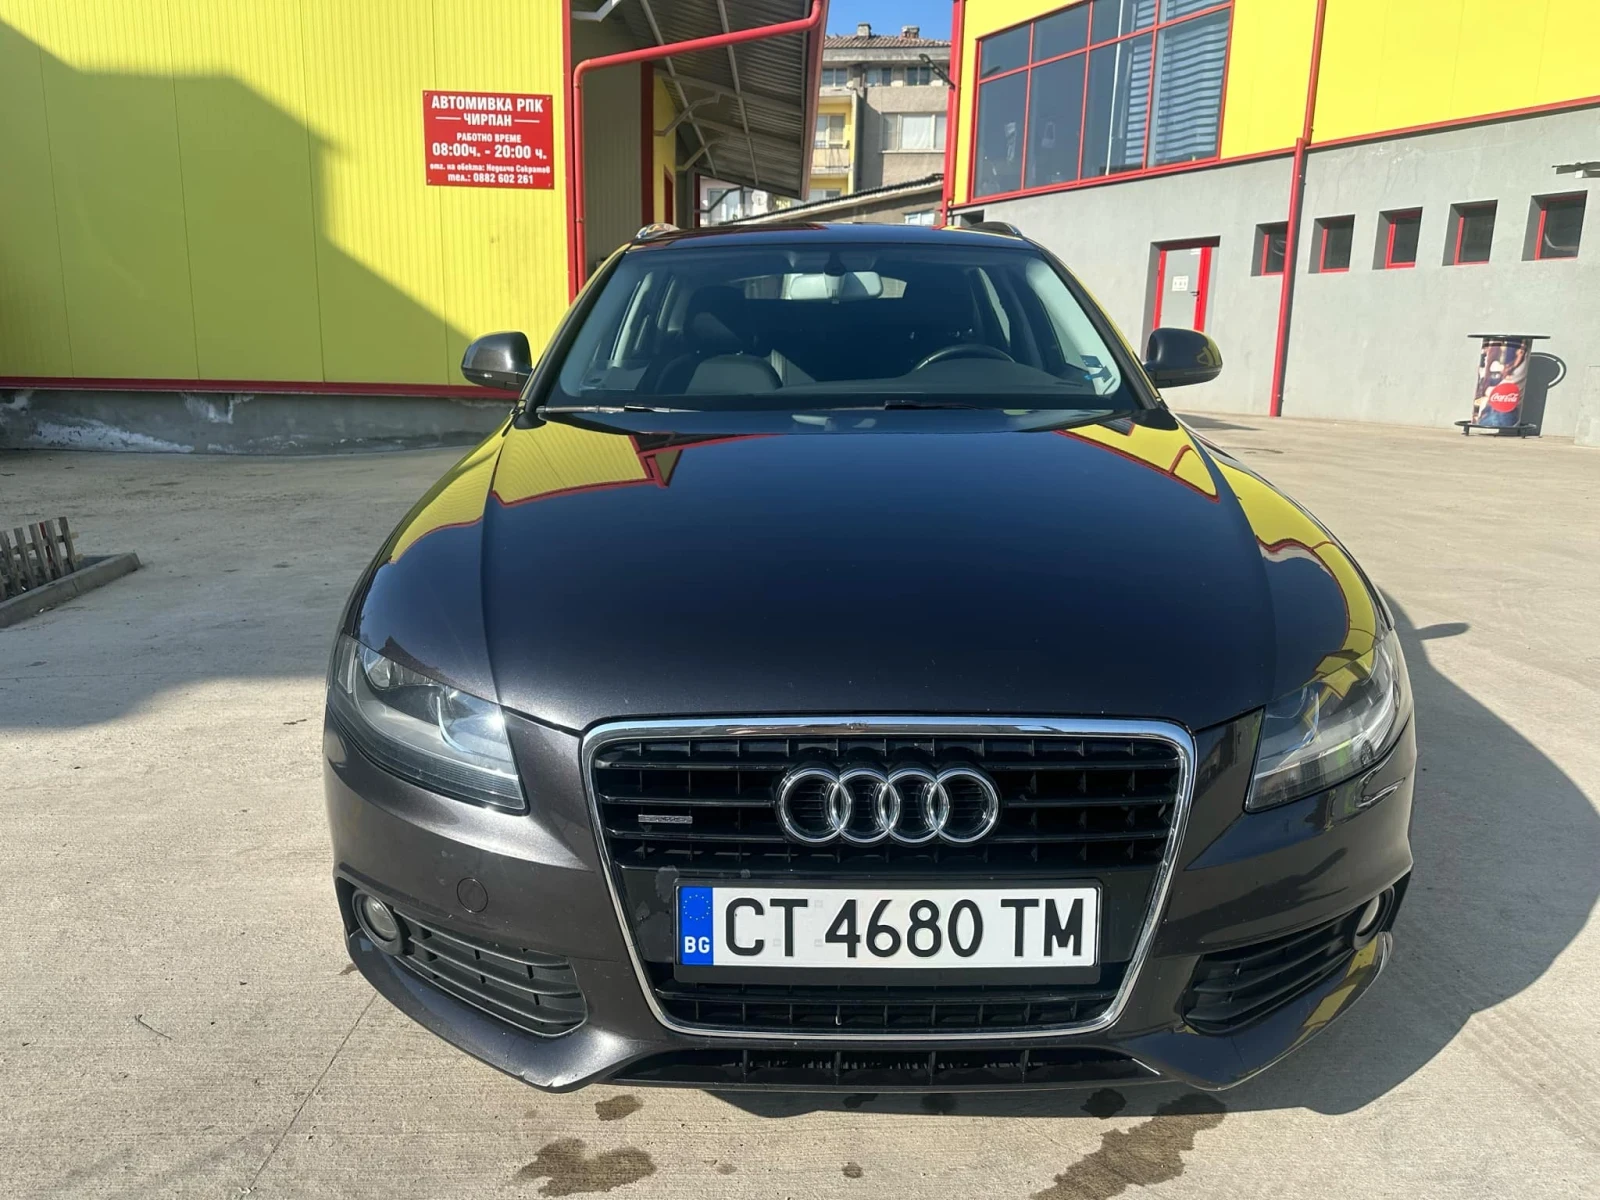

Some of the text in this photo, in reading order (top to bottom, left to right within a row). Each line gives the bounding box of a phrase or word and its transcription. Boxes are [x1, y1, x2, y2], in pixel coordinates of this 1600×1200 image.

[431, 95, 544, 113] АВТОМИВКА РПК
[463, 112, 512, 127] ЧИРПАН
[456, 132, 522, 143] РАБОТНО ВРЕМЕ
[432, 142, 481, 157] 08:00ч.
[494, 144, 531, 159] 20:00
[535, 148, 547, 160] ч.
[473, 173, 496, 183] 0882
[497, 174, 515, 184] 602
[517, 175, 534, 185] 261
[725, 897, 1084, 958] CT 4680 TM
[683, 936, 711, 954] BG
